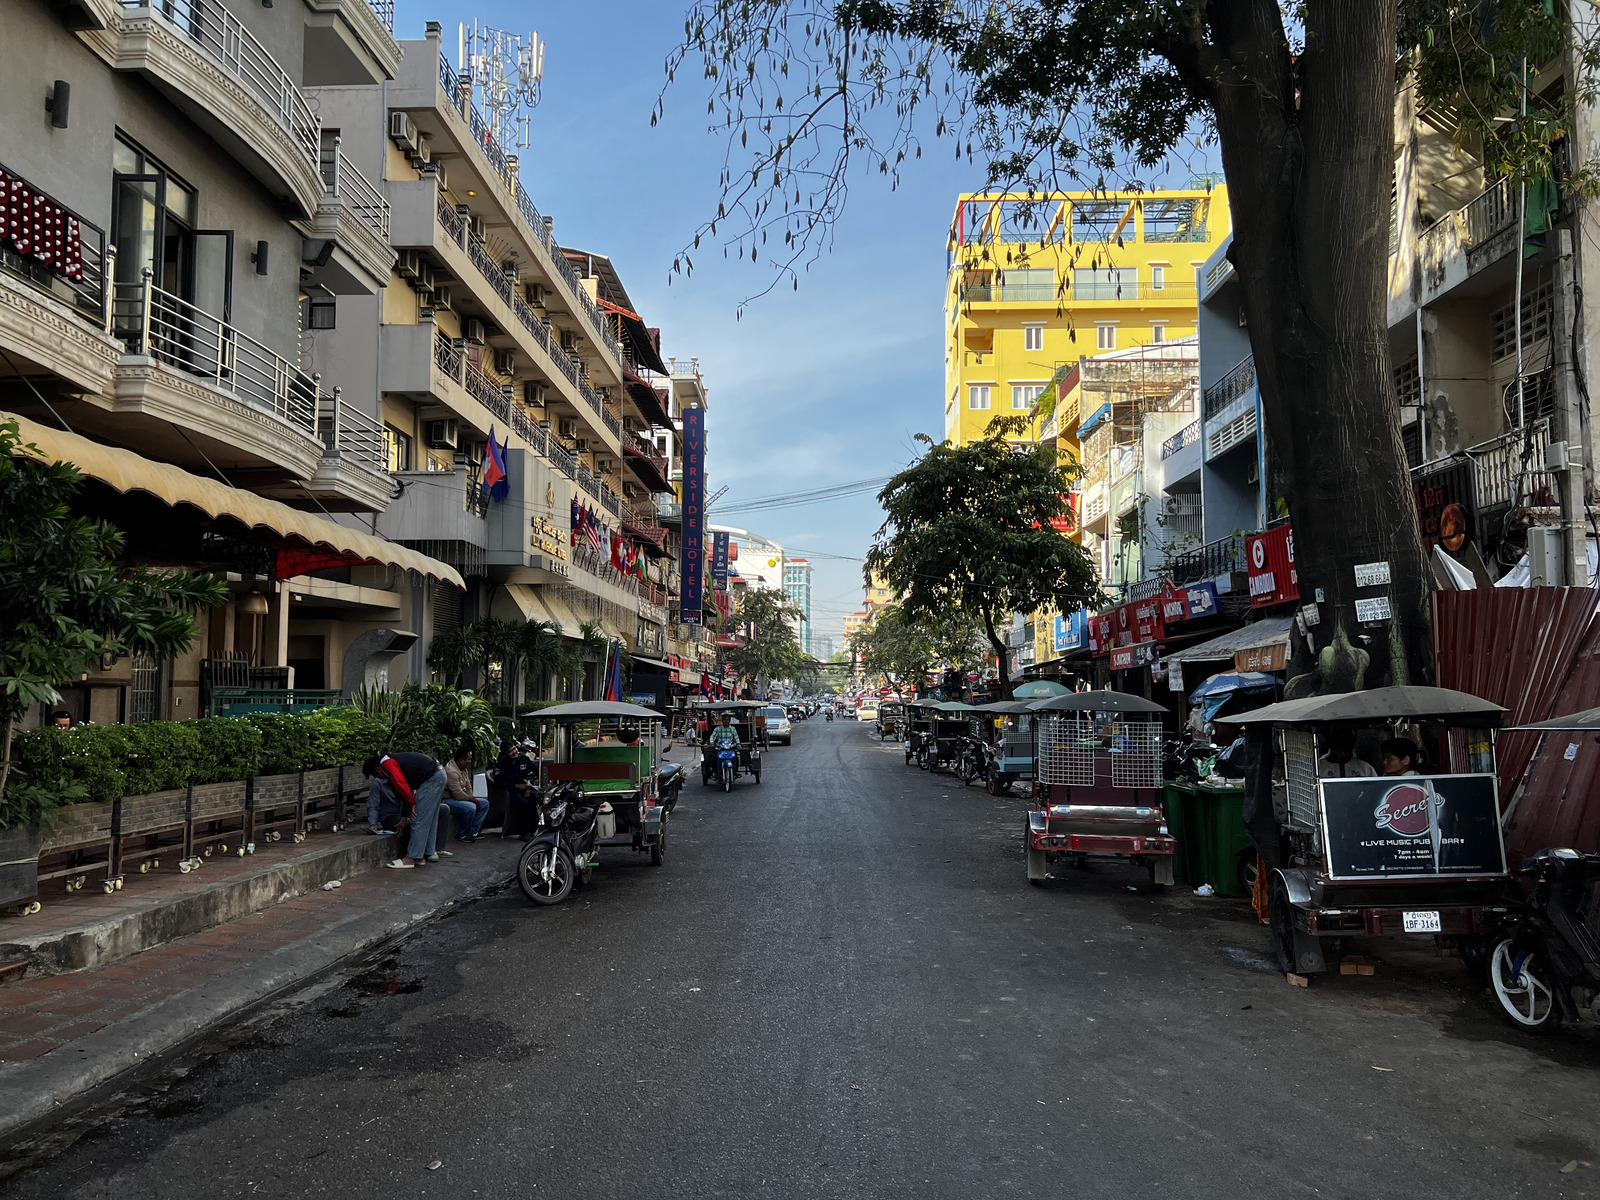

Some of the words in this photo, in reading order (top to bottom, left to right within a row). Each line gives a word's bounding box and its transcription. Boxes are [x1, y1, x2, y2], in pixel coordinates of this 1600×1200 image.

[688, 415, 698, 528] RIVERSIDE
[688, 537, 697, 598] HOTEL
[1374, 793, 1445, 828] Secres
